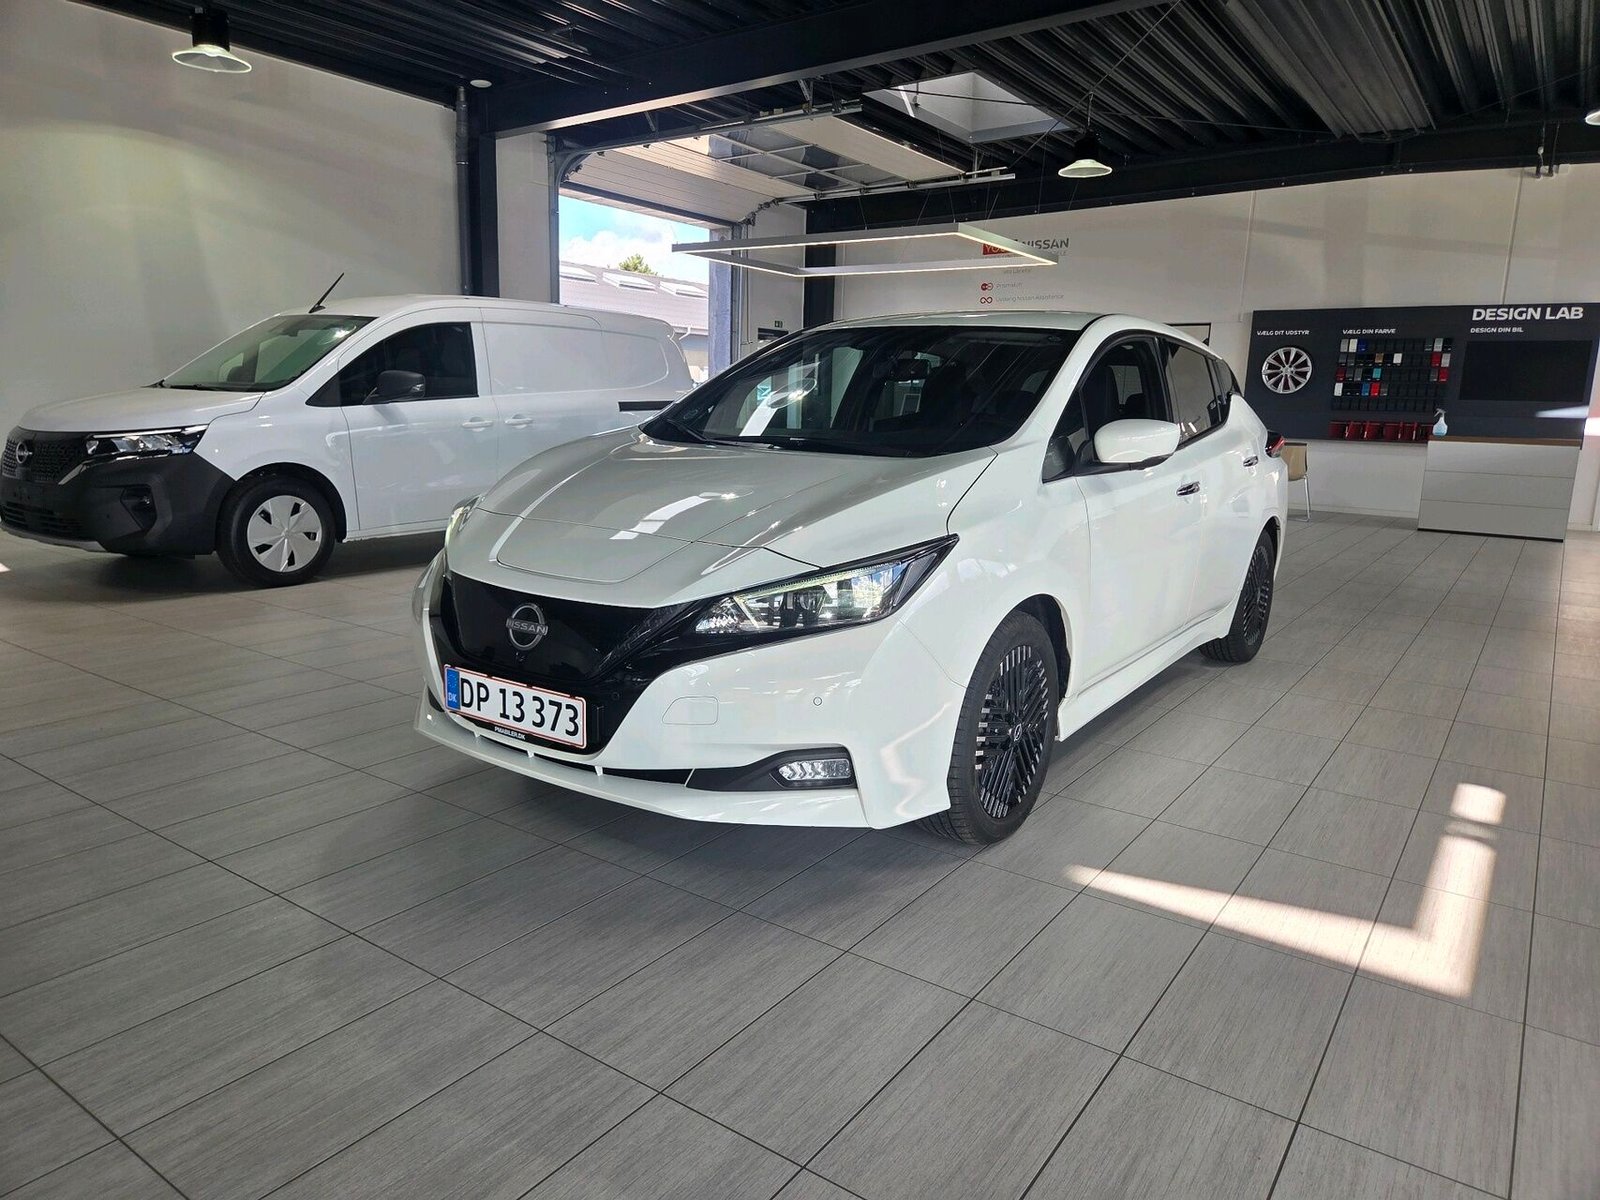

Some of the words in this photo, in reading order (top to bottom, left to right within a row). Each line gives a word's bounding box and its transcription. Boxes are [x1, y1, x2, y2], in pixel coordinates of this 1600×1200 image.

[1472, 308, 1541, 320] DESIGN
[1545, 307, 1584, 319] LAB
[507, 620, 548, 635] NISSAN
[449, 692, 458, 703] DK
[460, 678, 490, 711] DP
[499, 688, 525, 723] 13
[532, 696, 579, 737] 373
